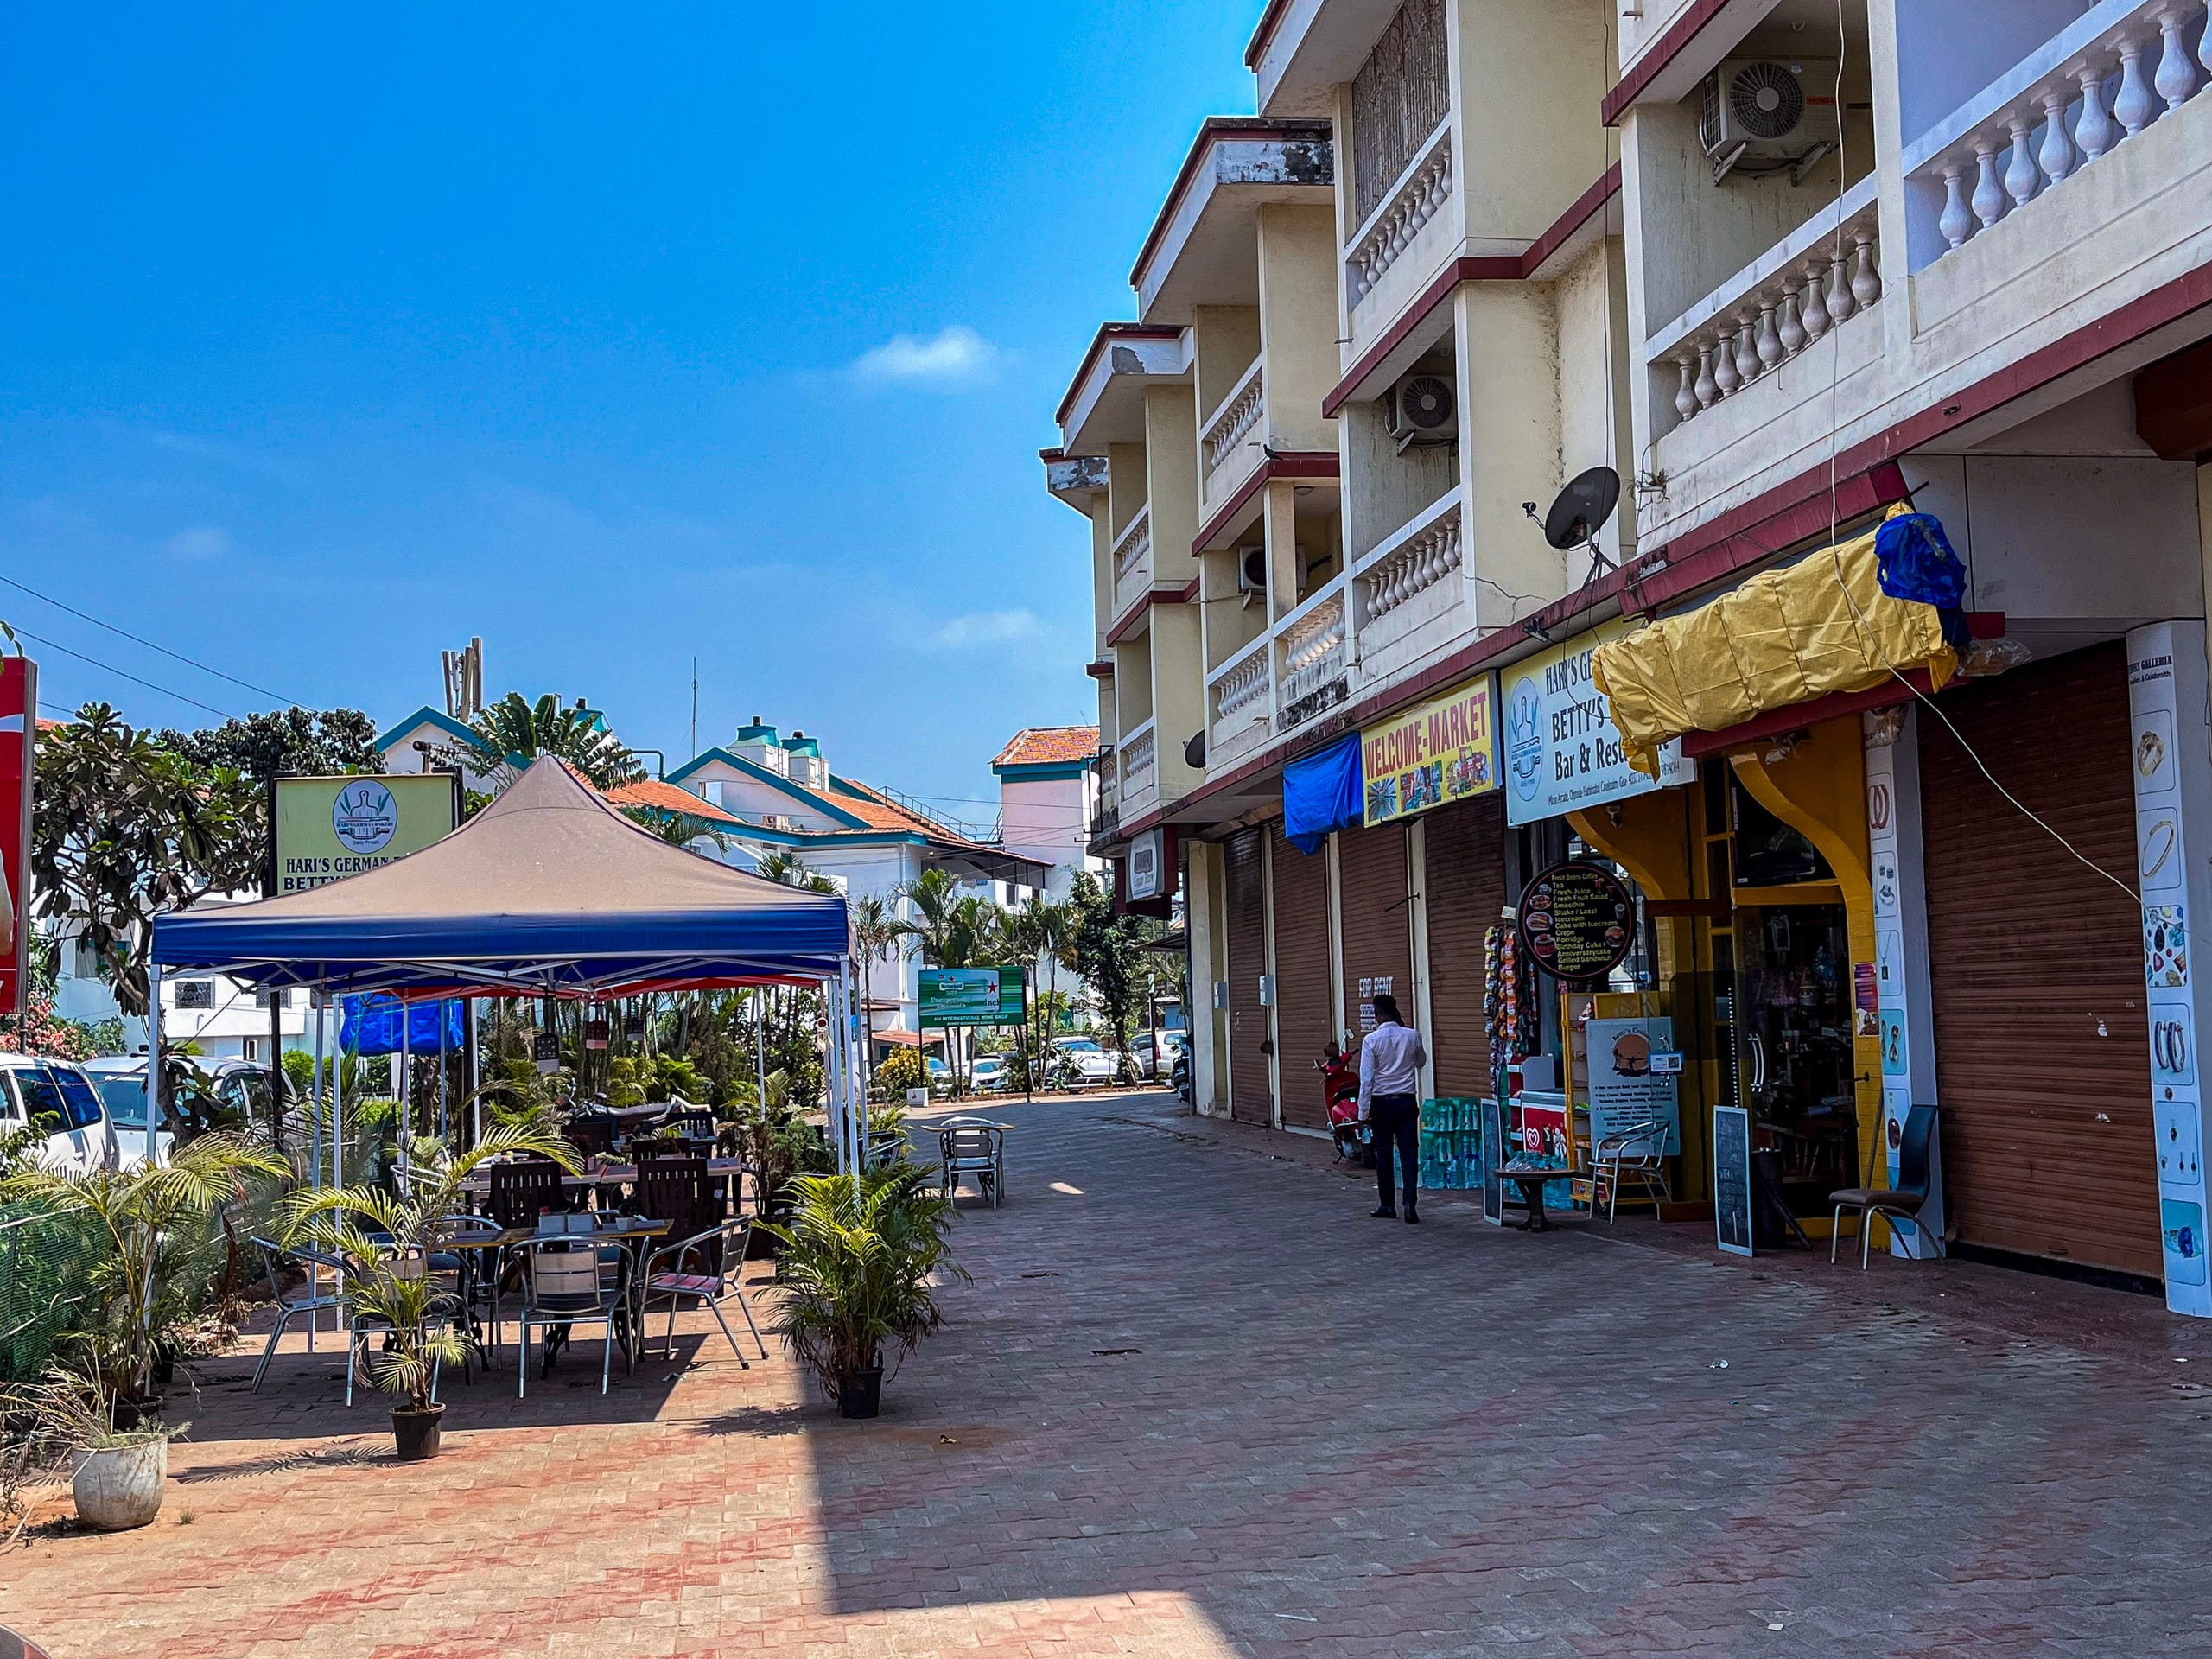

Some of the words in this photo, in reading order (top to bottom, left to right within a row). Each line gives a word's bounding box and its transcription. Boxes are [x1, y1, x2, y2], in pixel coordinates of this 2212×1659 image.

[1546, 656, 1578, 696] HARI'S
[1580, 649, 1593, 682] GE
[2141, 655, 2172, 670] GALLERIA
[1364, 691, 1486, 781] WELCOME-MARKET
[1552, 696, 1605, 743] BETTY'S
[1555, 750, 1575, 782] Bar
[1580, 742, 1591, 774] &
[1596, 735, 1628, 770] Rest
[286, 857, 330, 873] HARI'S
[1359, 978, 1371, 998] FOR
[1374, 976, 1394, 996] RENT
